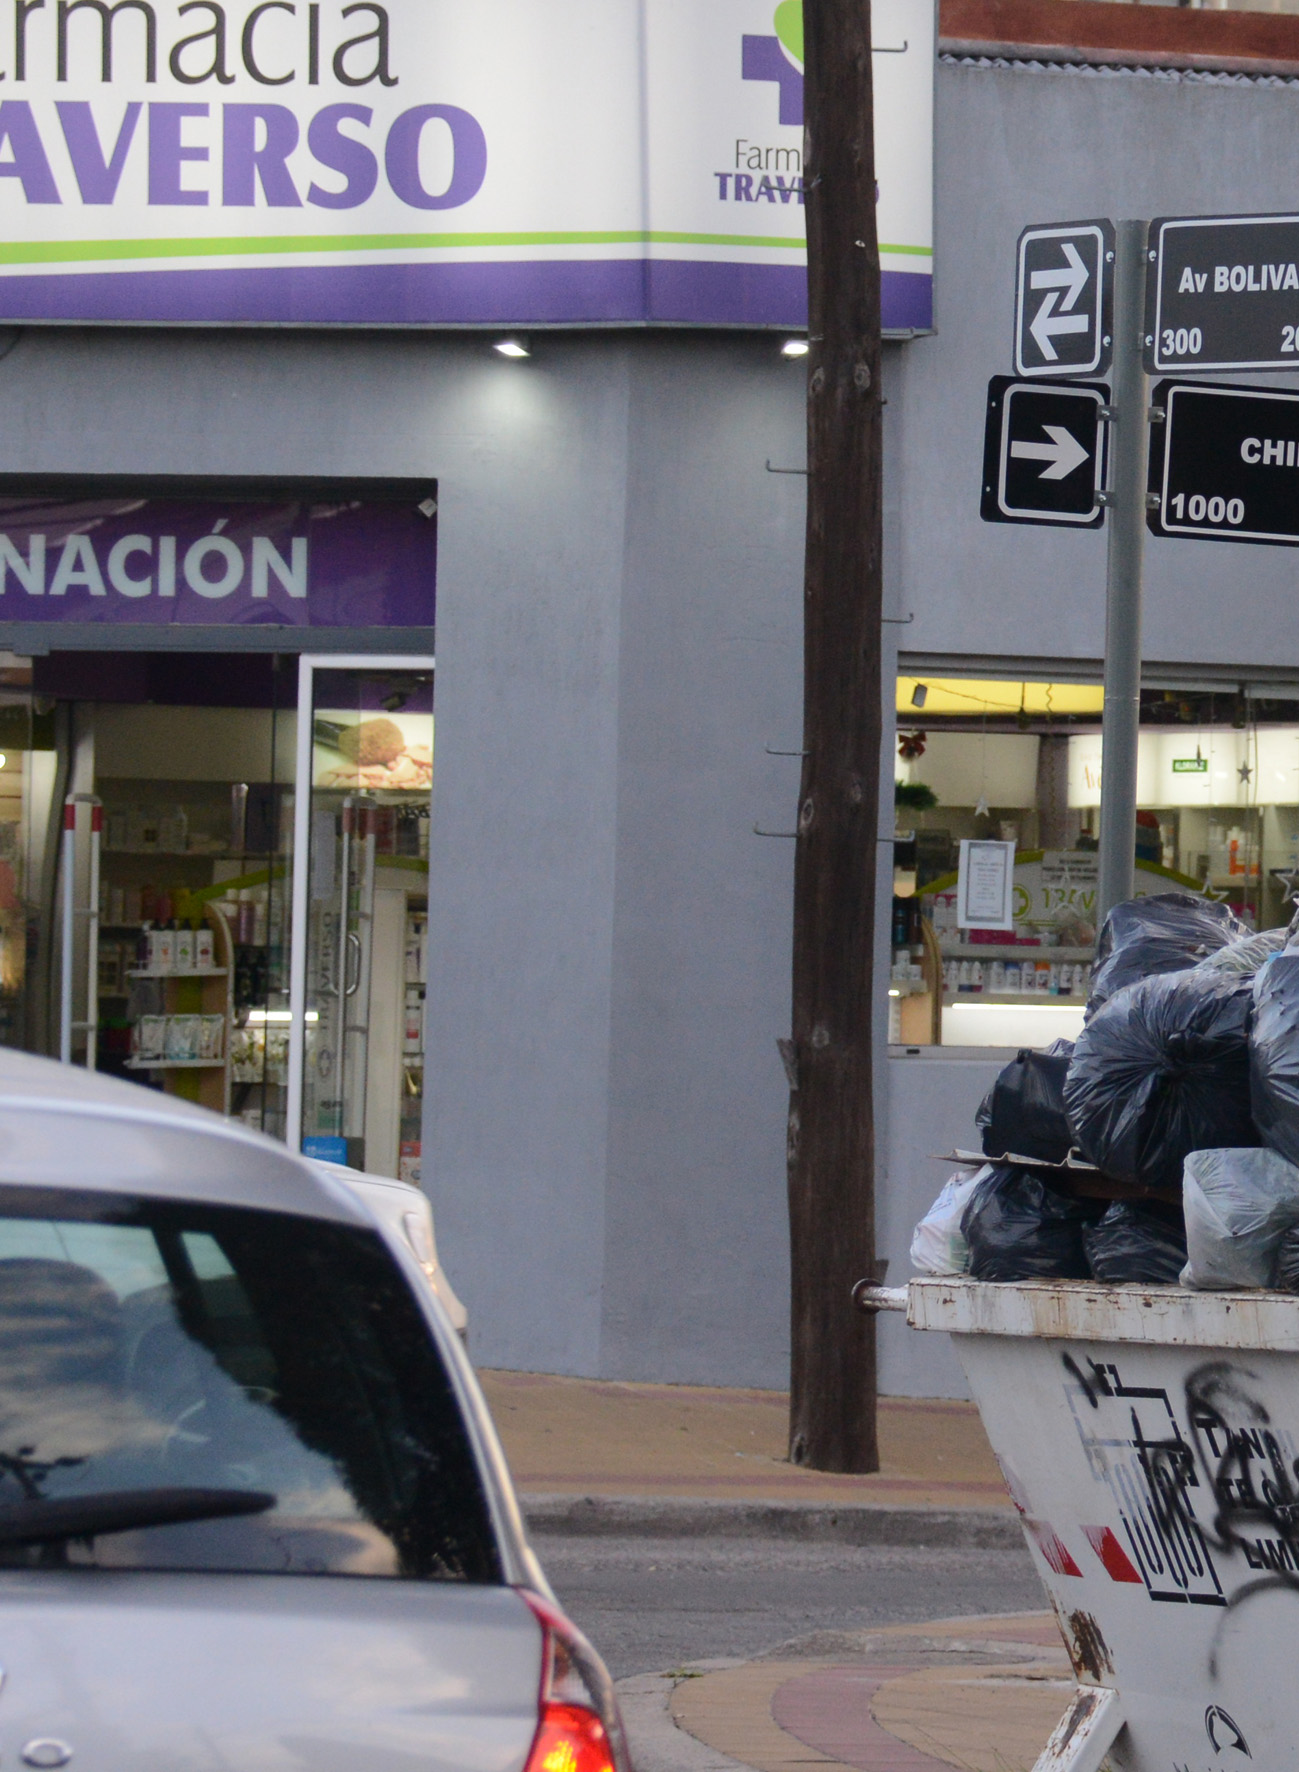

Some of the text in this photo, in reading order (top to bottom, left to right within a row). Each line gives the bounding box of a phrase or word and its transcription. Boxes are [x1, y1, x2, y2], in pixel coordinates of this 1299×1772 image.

[0, 0, 399, 87] rmacia
[735, 139, 801, 172] Farm
[1178, 267, 1208, 293] Av
[1161, 328, 1202, 355] 300
[1171, 493, 1245, 525] 1000
[0, 518, 308, 599] NACIÓN
